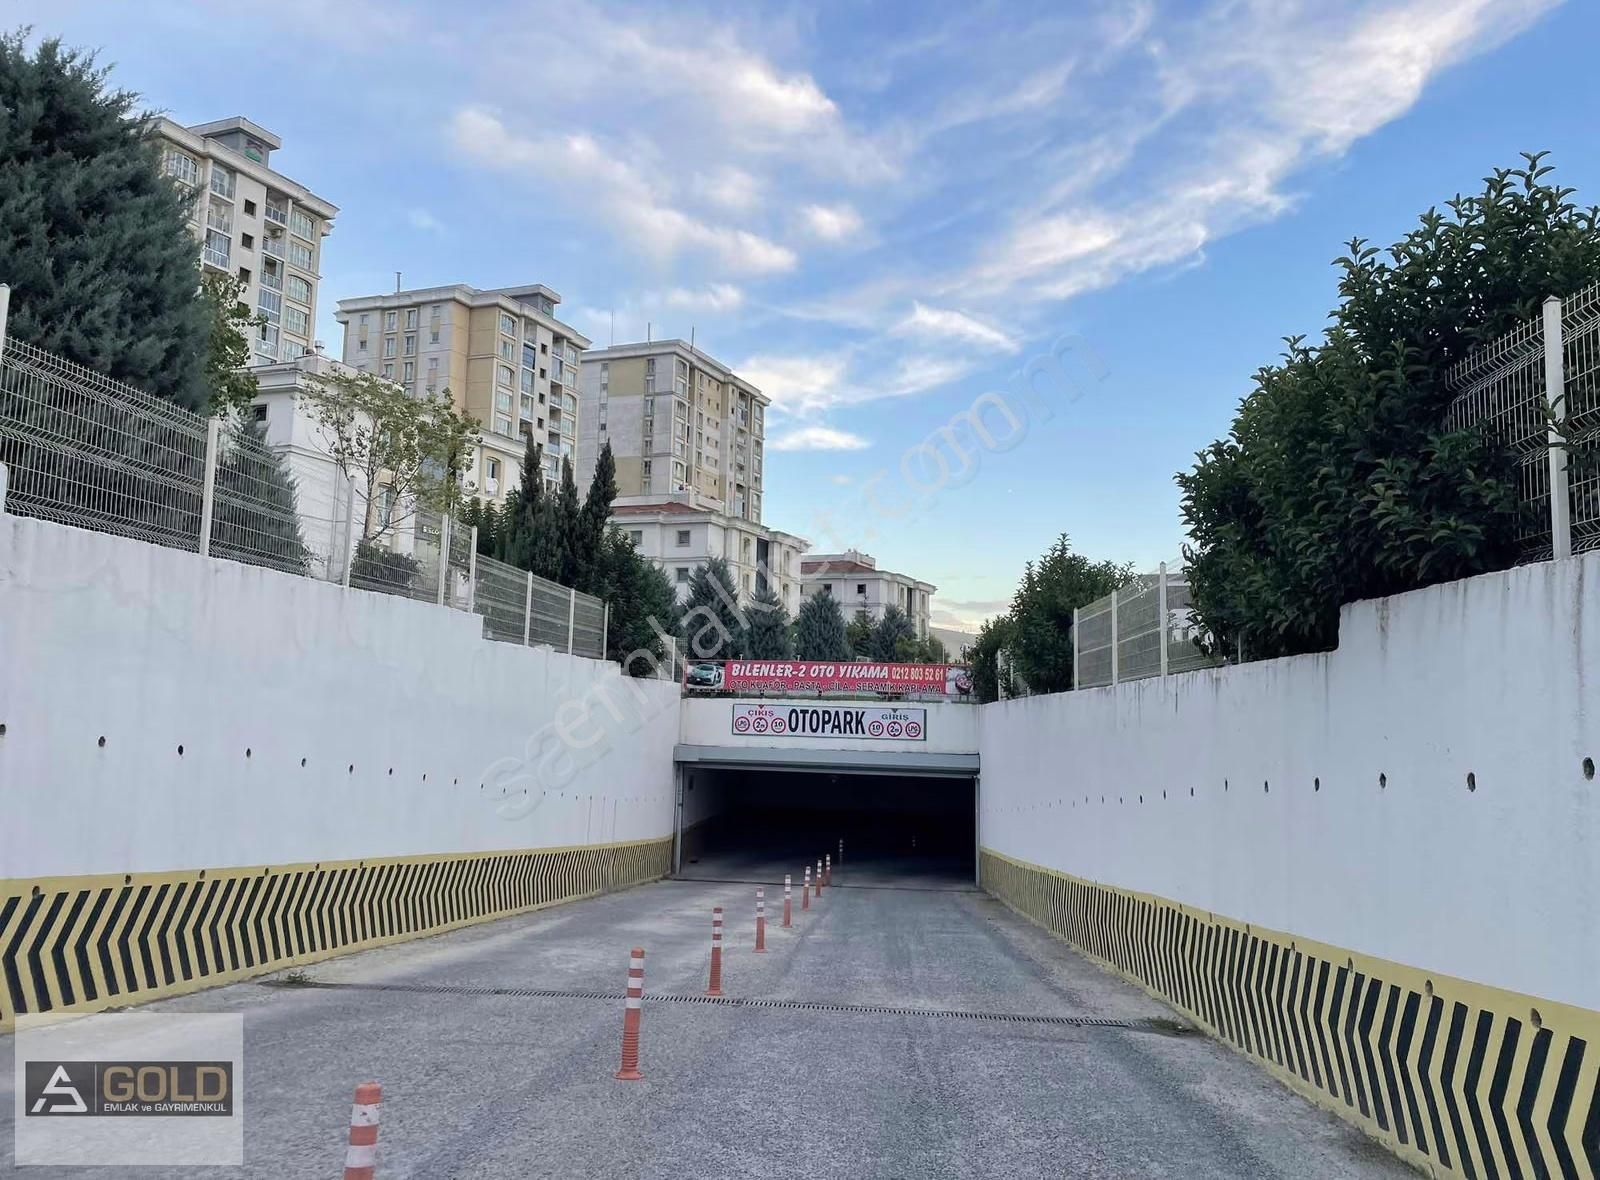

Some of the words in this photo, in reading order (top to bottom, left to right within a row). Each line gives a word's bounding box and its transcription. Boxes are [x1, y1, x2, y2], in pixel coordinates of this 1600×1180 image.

[810, 665, 834, 678] OTO
[839, 665, 889, 679] YIKAMA
[891, 667, 909, 680] 0212
[729, 680, 749, 690] OTO
[794, 681, 821, 691] PASTA
[788, 708, 866, 735] OTOPARK
